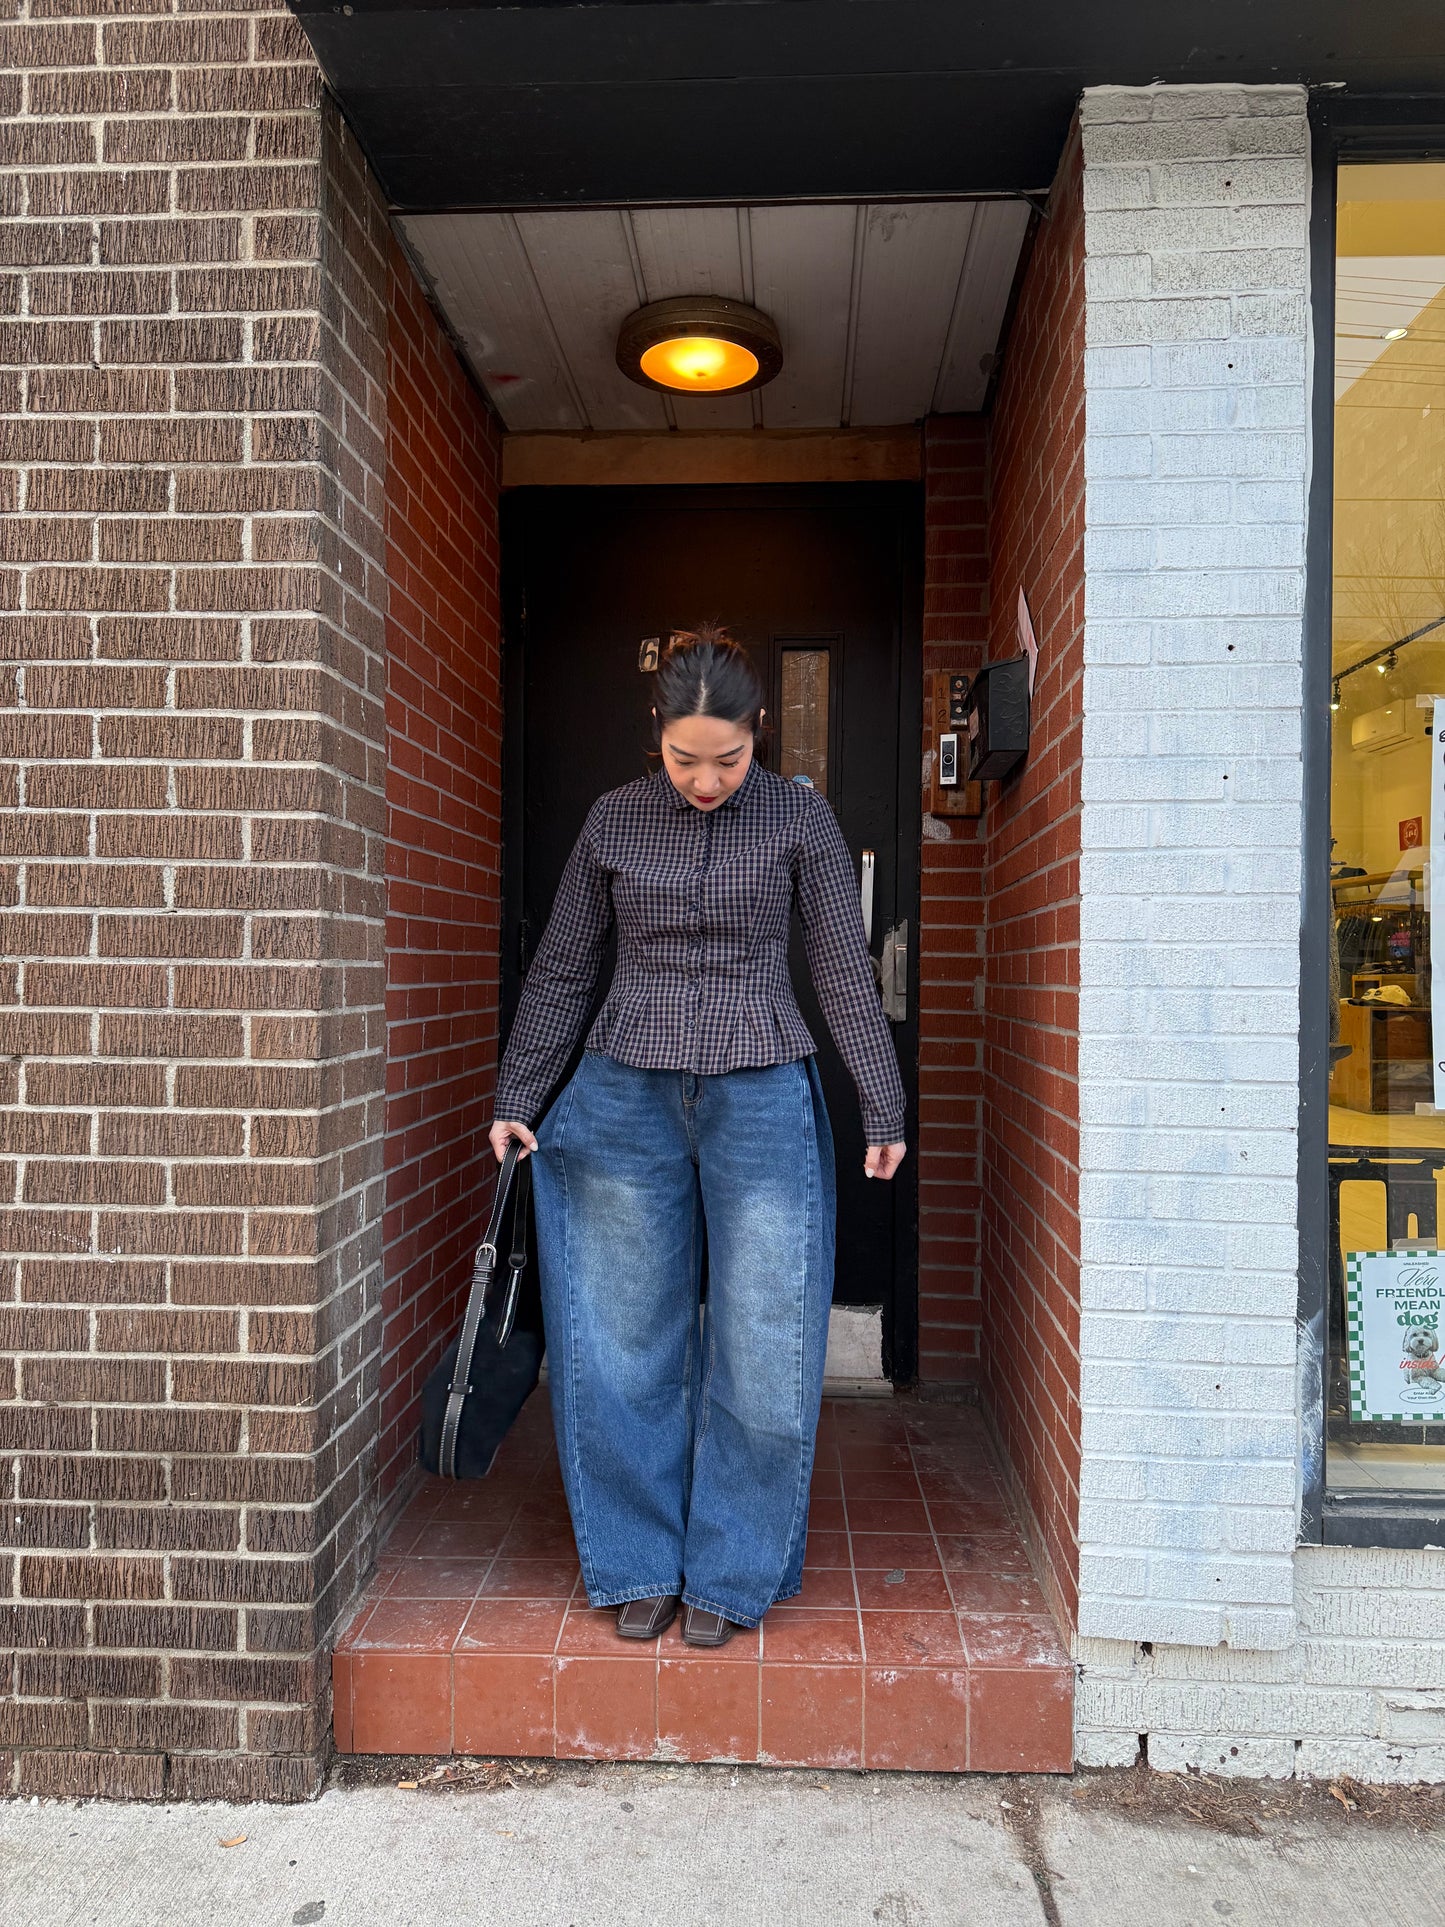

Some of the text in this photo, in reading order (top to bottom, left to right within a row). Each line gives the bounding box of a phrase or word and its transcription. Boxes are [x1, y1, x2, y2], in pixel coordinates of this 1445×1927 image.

[938, 709, 946, 723] 2
[1397, 1267, 1439, 1290] Very
[1394, 1300, 1440, 1310] MEAN
[1397, 1311, 1438, 1330] dog
